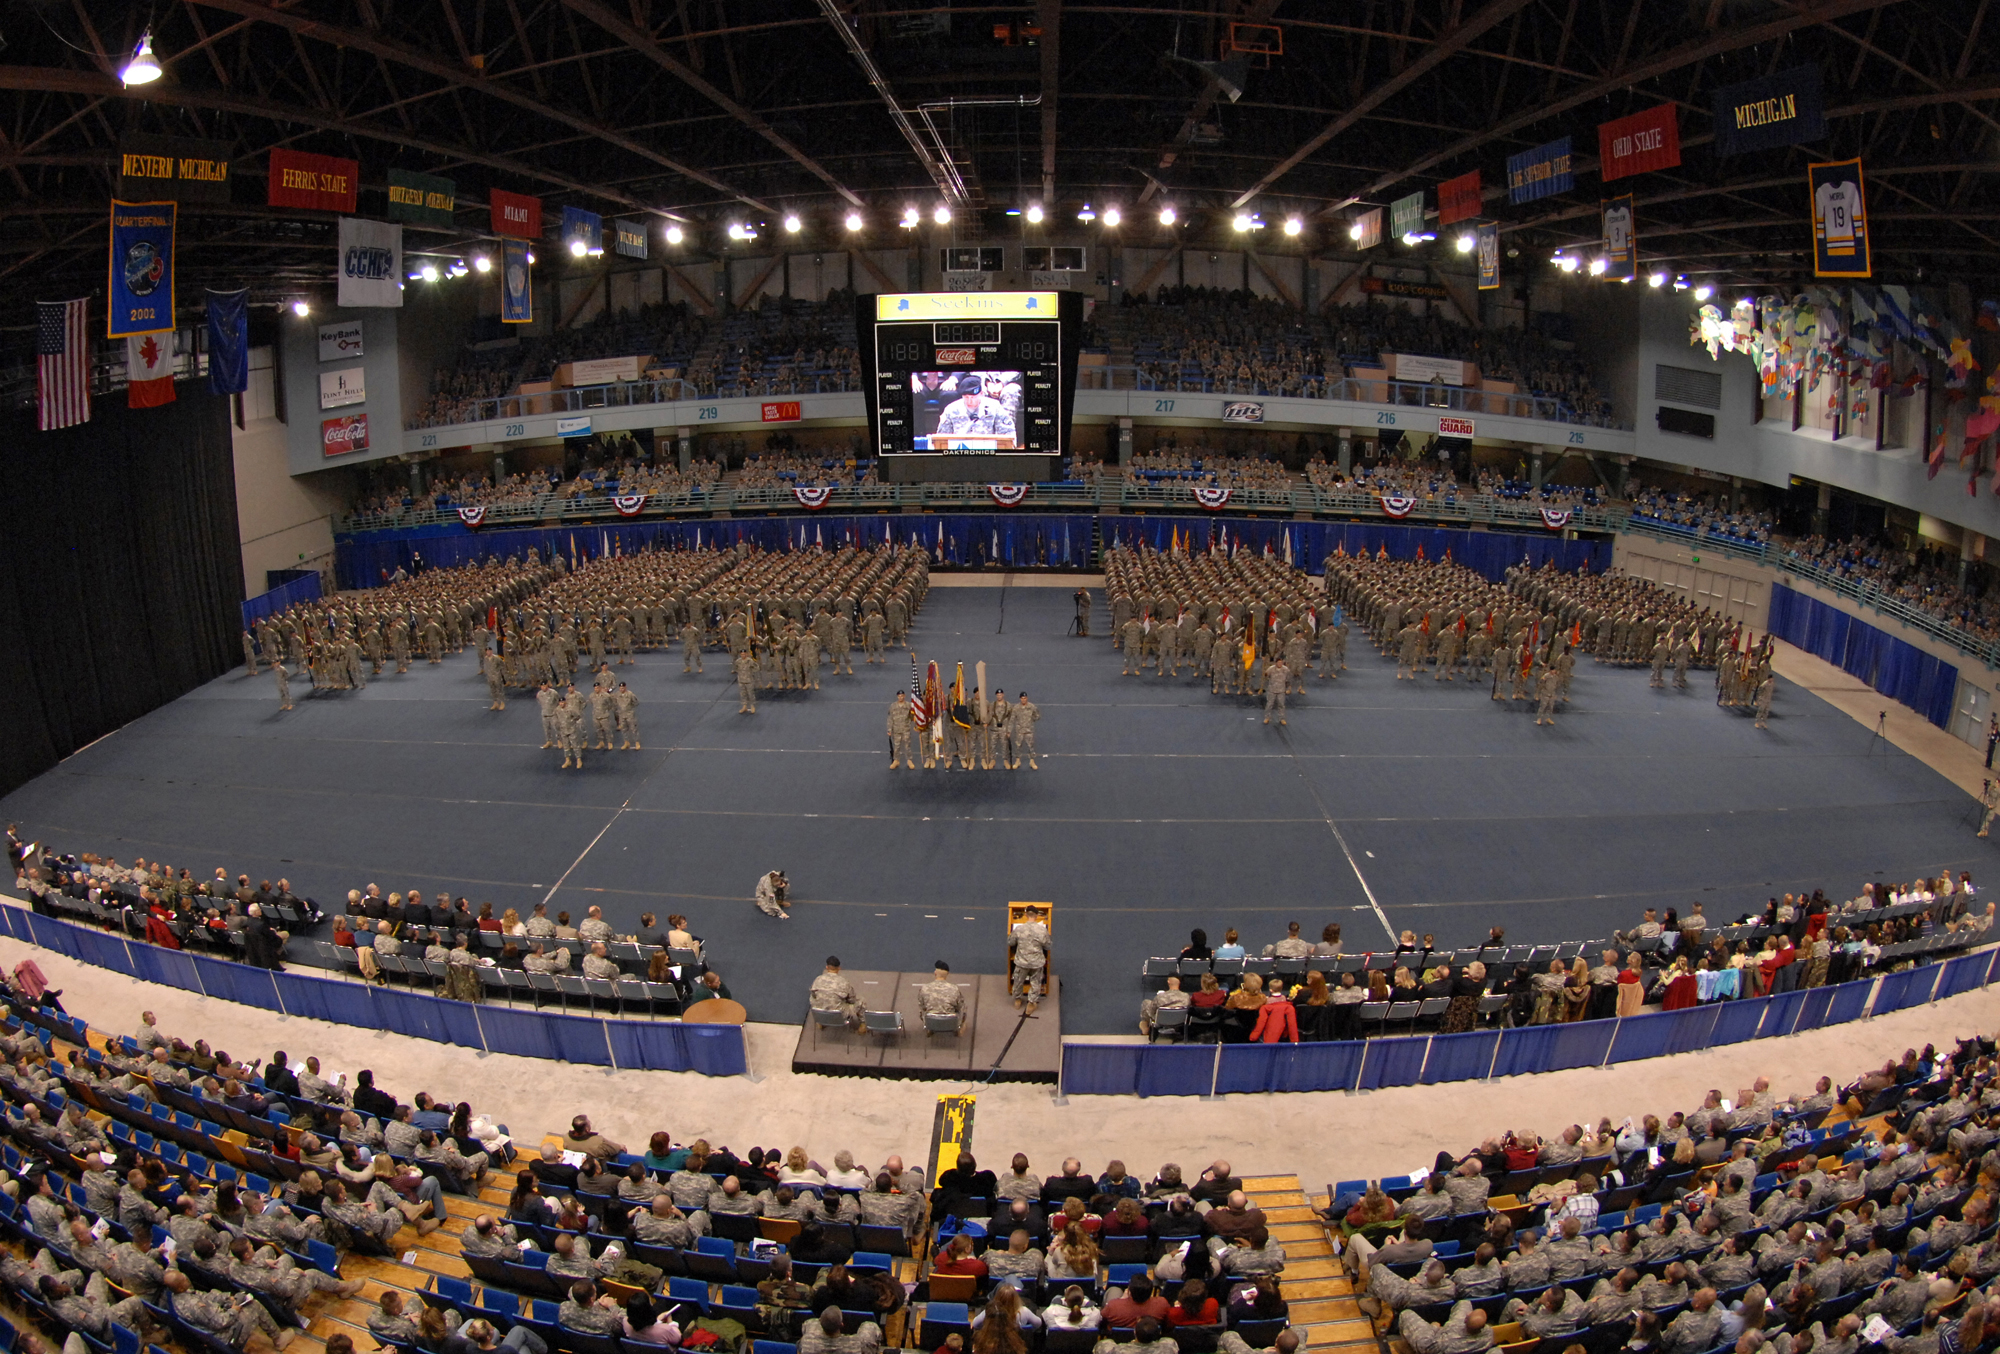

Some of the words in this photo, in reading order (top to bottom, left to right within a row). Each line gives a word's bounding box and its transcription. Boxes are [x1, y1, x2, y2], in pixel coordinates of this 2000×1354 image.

[1734, 94, 1796, 129] MICHIGAN
[1613, 136, 1632, 158] OHIO
[1634, 128, 1662, 153] STATE
[122, 154, 174, 178] WESTERN
[178, 158, 228, 181] MICHIGAN
[282, 168, 318, 190] FERRIS
[321, 173, 347, 194] STATE
[504, 205, 528, 223] MIAMI
[1832, 206, 1845, 228] 19
[1615, 227, 1620, 242] 3
[931, 296, 1003, 308] Seekins
[130, 308, 155, 321] 2002
[321, 328, 360, 342] KeyBank
[323, 391, 342, 399] FLINT
[345, 388, 364, 396] HILLS
[1155, 400, 1175, 412] 217
[1226, 406, 1260, 418] Lite
[699, 407, 718, 419] 219
[1377, 412, 1396, 424] 216
[506, 424, 524, 436] 220
[1440, 422, 1473, 435] GUARD
[422, 434, 437, 446] 221
[1569, 432, 1584, 444] 215
